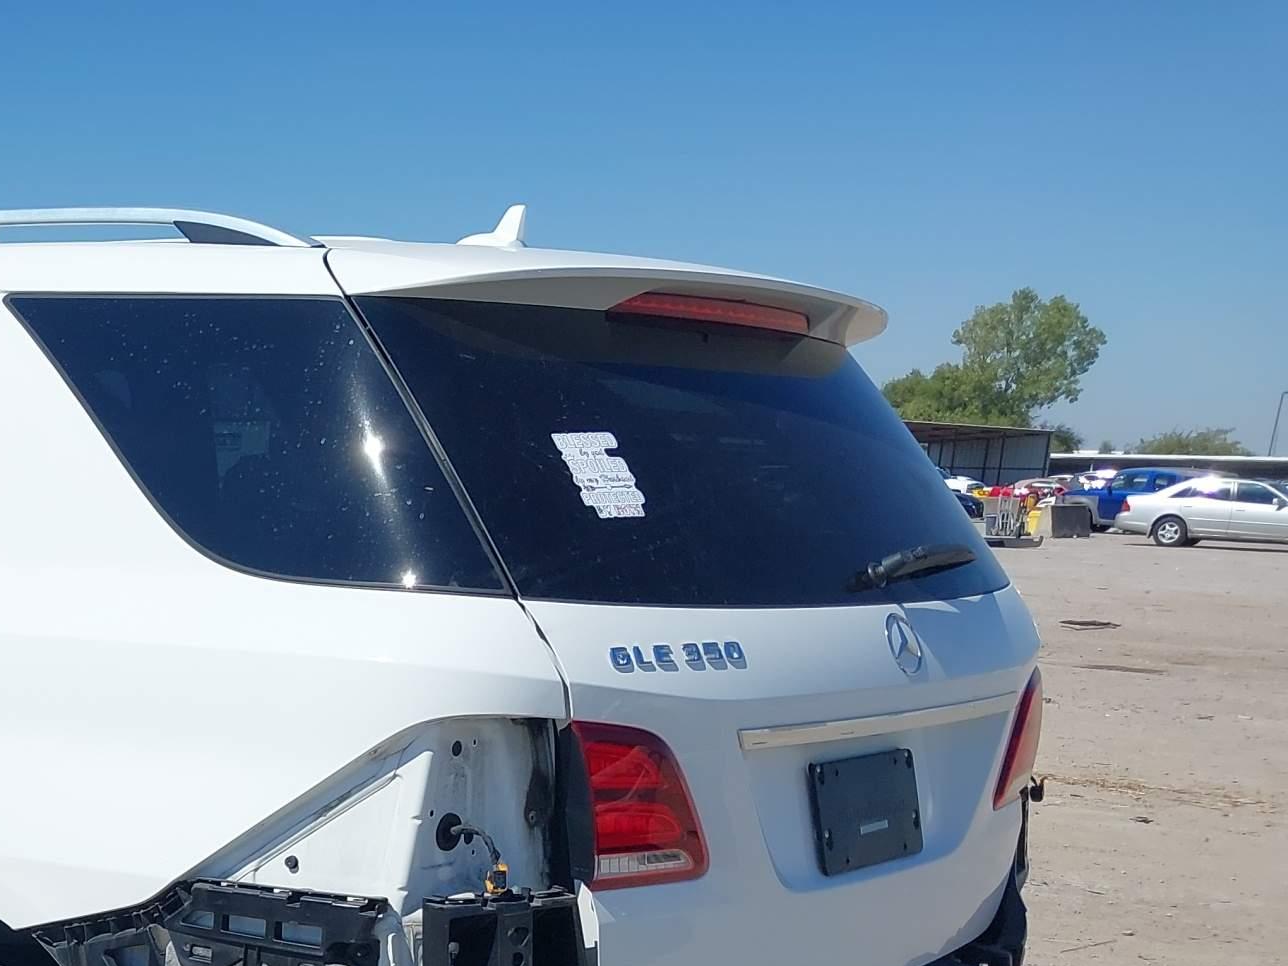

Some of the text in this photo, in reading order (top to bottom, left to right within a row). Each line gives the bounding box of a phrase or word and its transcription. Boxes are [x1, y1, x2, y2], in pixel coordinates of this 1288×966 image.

[554, 433, 617, 449] BLESSED
[569, 459, 627, 474] SPOILED
[582, 491, 643, 504] PROTECTED
[609, 641, 748, 673] GLE 350
